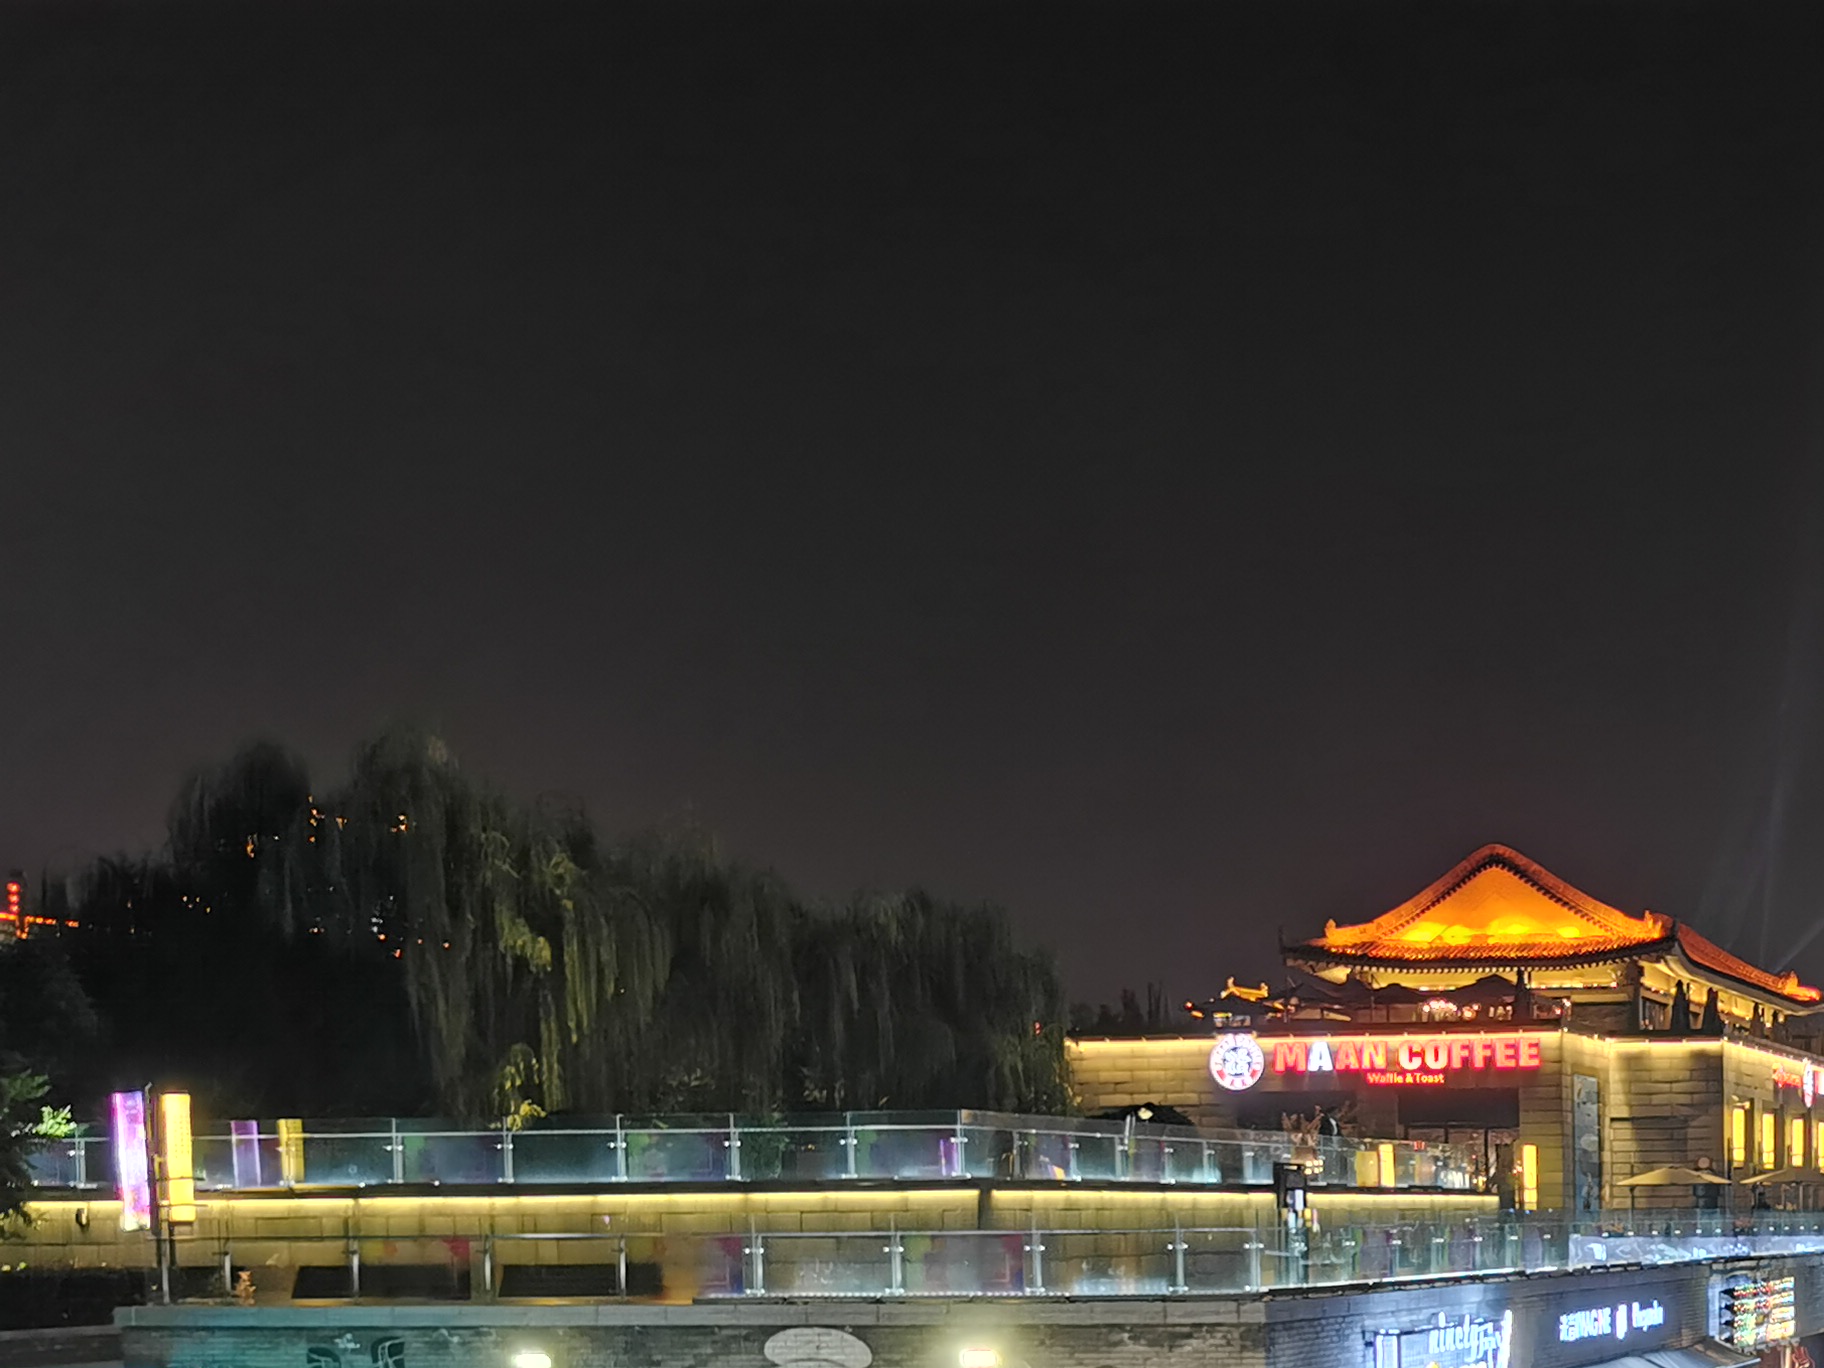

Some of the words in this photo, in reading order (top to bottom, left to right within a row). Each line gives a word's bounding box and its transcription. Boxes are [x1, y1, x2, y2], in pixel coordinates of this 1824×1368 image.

[1273, 1041, 1389, 1073] MAAN
[1396, 1037, 1542, 1071] COFFEE
[1367, 1072, 1404, 1085] Waffle
[1415, 1072, 1445, 1085] Toast
